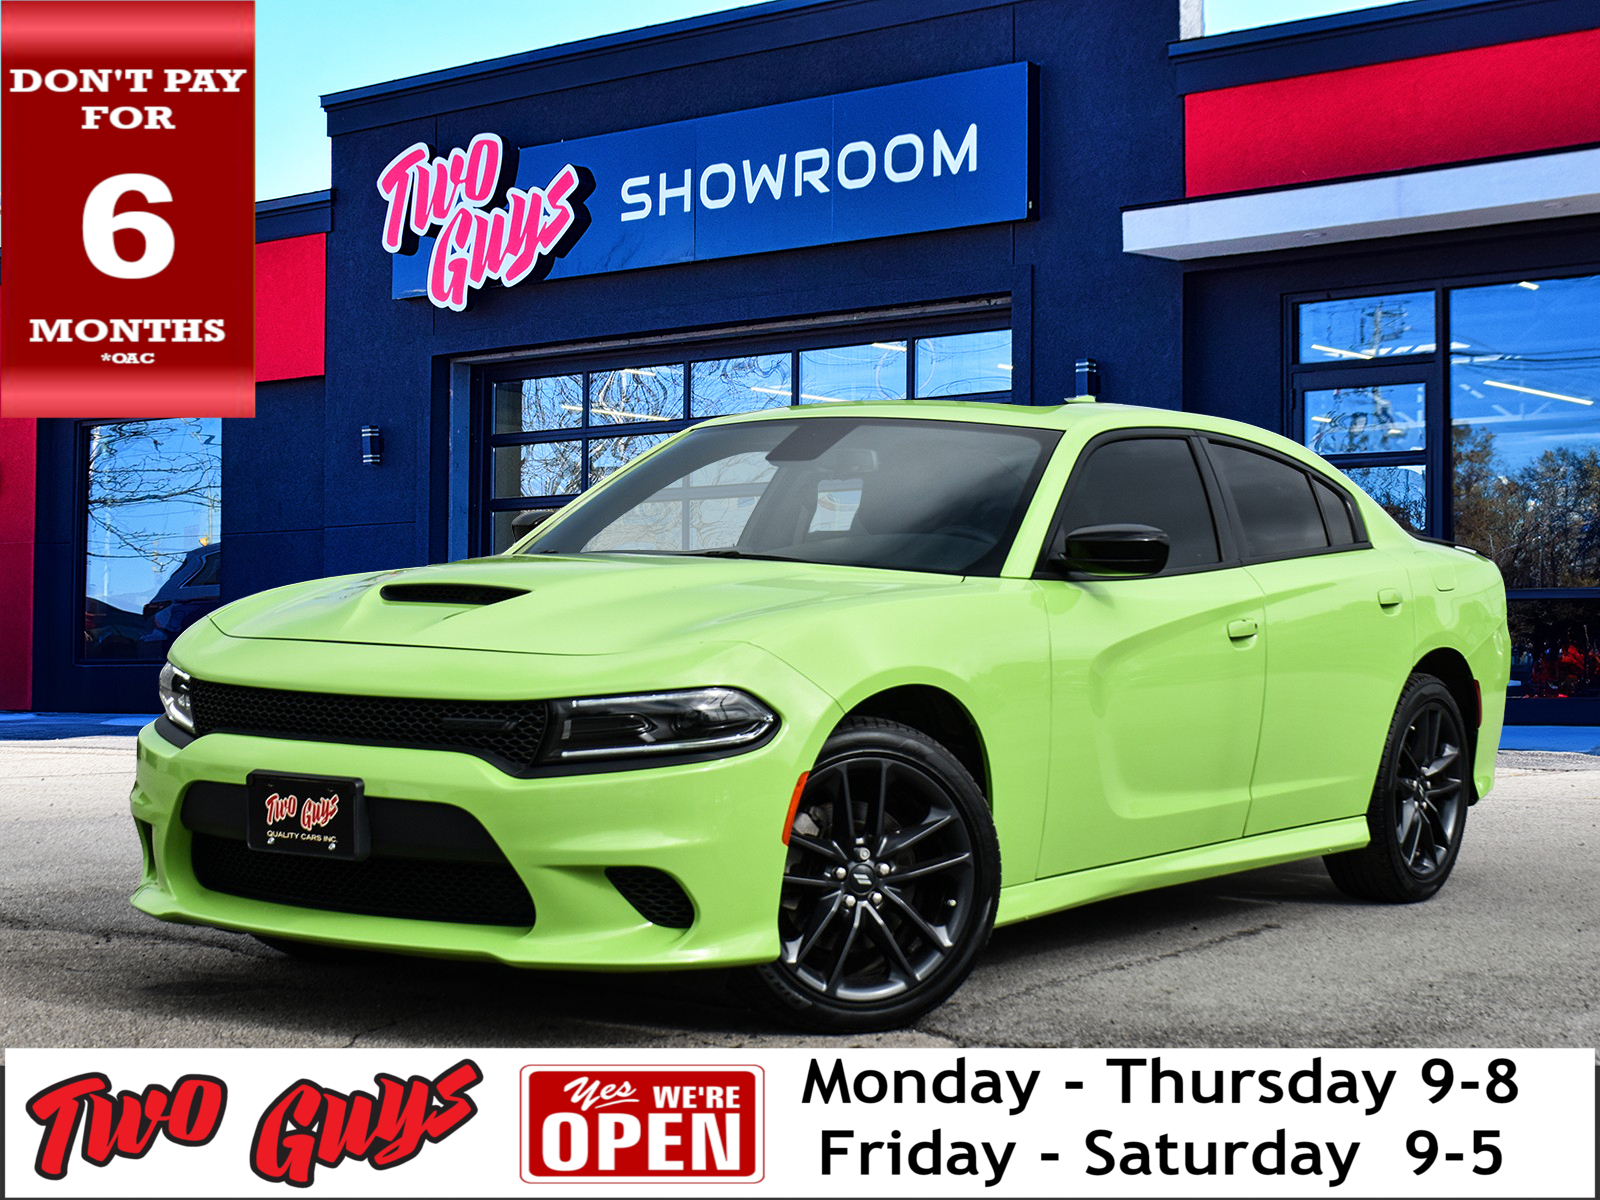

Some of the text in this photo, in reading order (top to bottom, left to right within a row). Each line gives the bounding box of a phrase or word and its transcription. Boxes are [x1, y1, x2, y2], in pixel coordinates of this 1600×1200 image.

[620, 123, 978, 222] SHOWROOM
[427, 163, 579, 312] Guys
[266, 829, 338, 843] QUALITY CARS INC.
[301, 794, 340, 831] Guys
